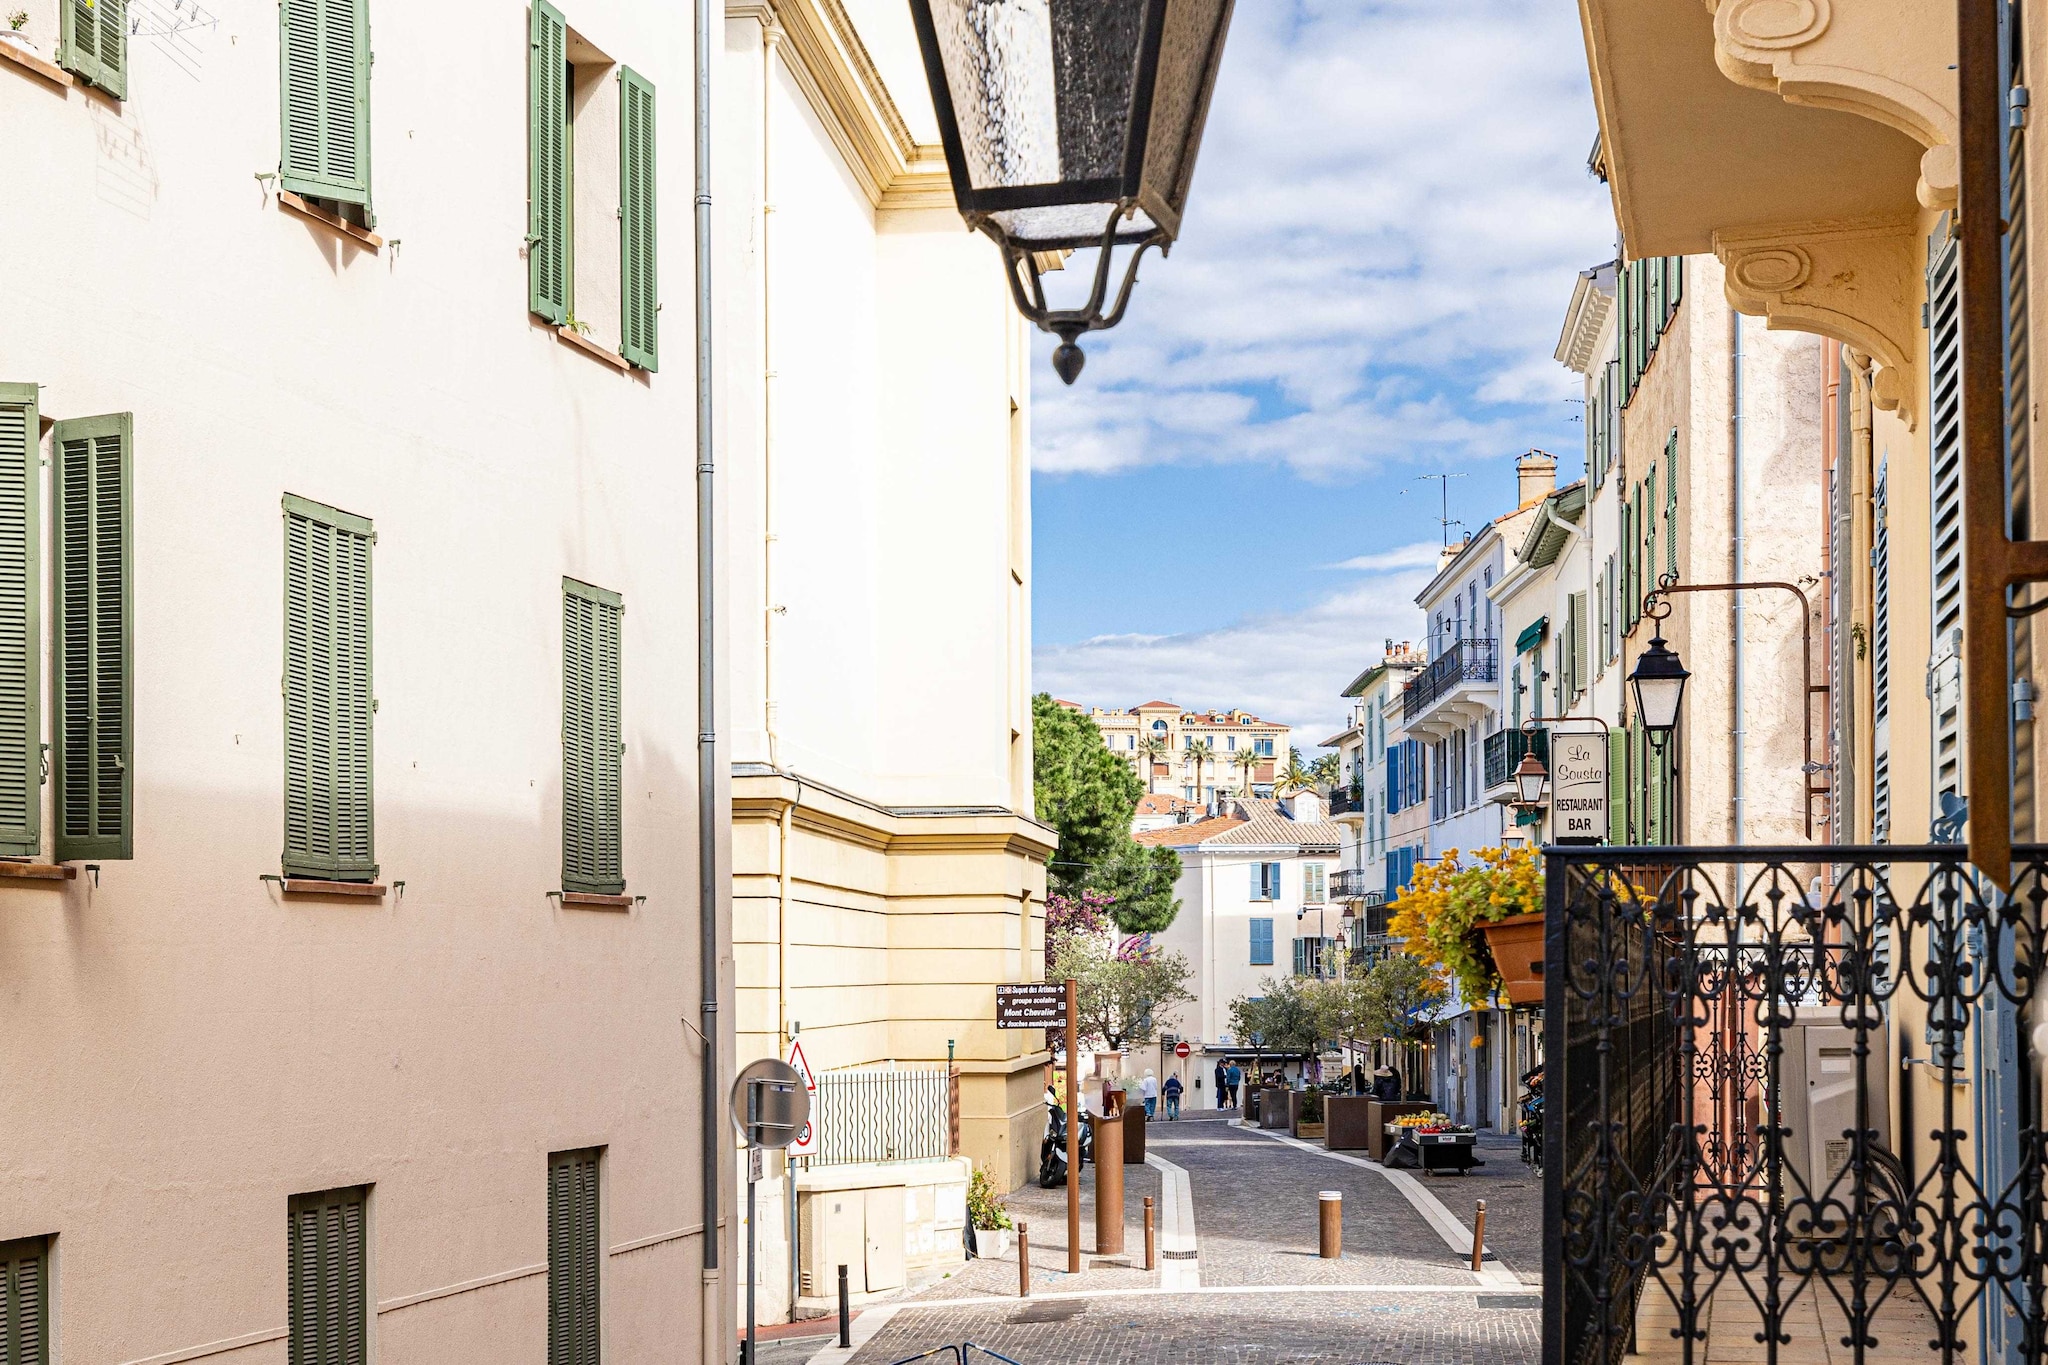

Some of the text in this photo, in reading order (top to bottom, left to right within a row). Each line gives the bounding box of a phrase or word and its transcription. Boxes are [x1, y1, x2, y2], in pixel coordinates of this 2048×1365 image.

[1568, 744, 1591, 762] La
[1557, 764, 1602, 781] Sousta
[1556, 798, 1603, 811] RESTAURANT
[1568, 818, 1591, 831] BAR
[1029, 986, 1037, 994] des
[1038, 986, 1056, 994] Artistes
[1012, 998, 1033, 1006] groupe
[1023, 1008, 1057, 1016] Chevalier
[1007, 1020, 1058, 1028] douches municipales
